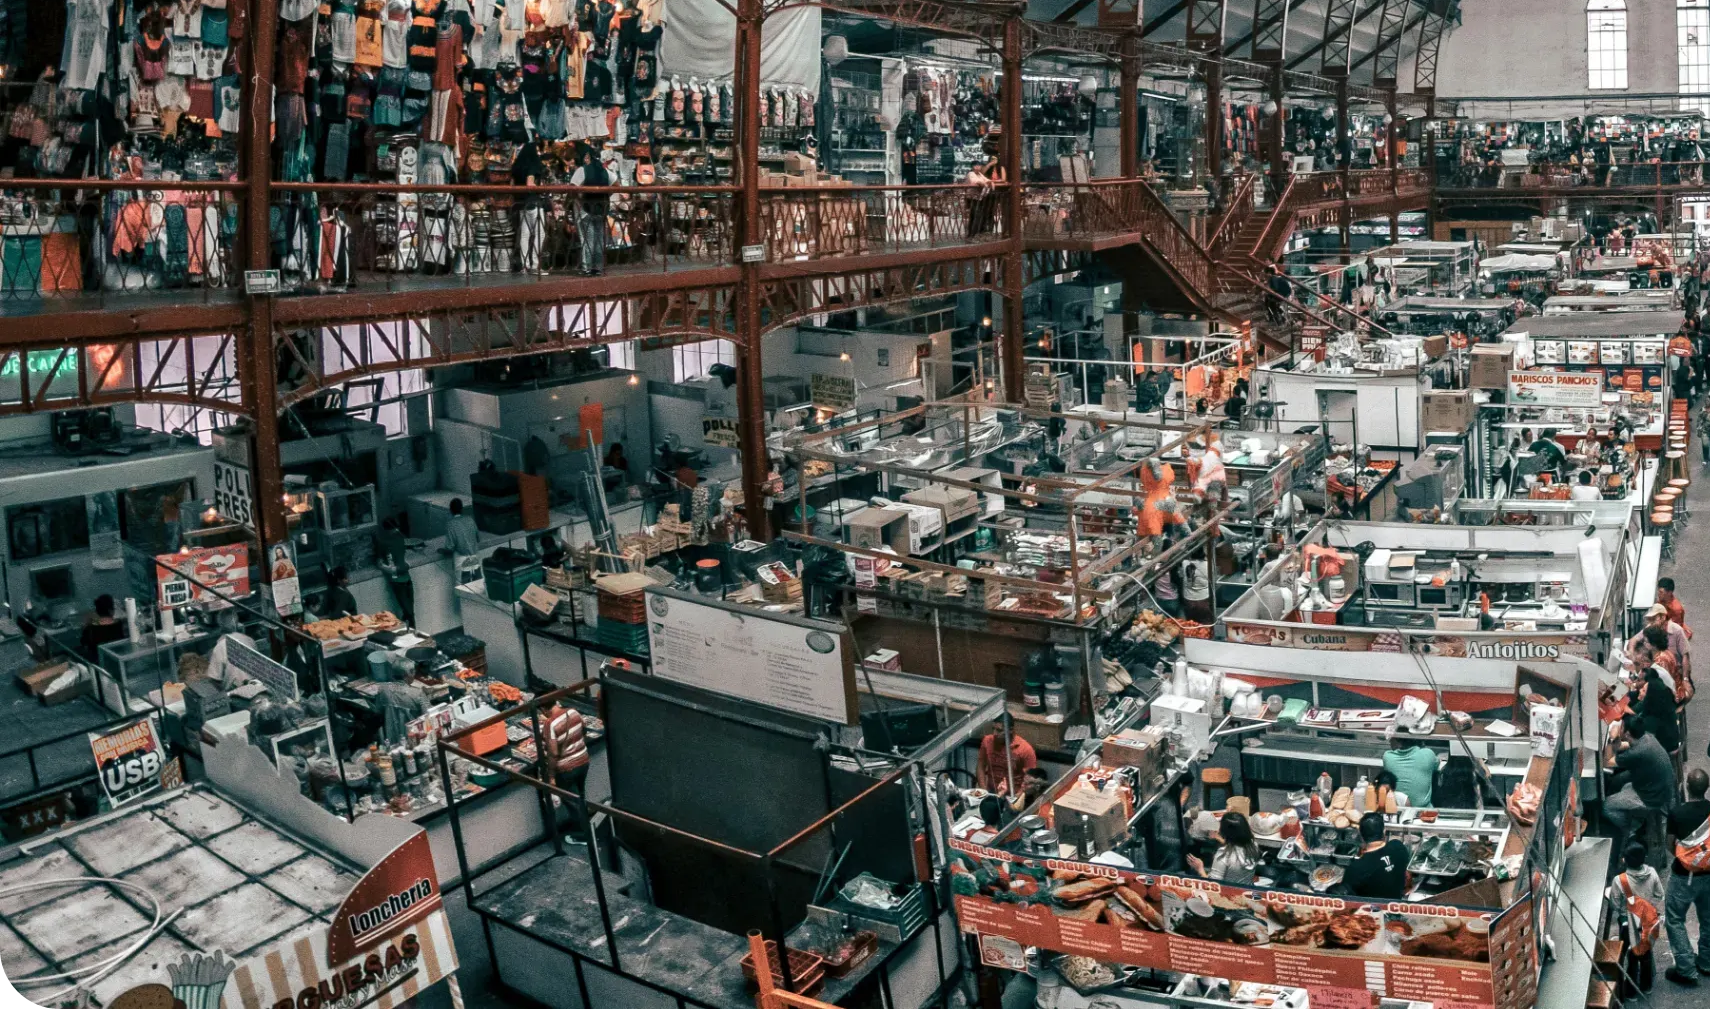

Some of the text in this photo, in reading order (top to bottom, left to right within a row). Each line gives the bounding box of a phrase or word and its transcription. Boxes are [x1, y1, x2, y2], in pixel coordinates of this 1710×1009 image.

[1511, 374, 1598, 385] MARISCOS PANCHO'S
[1303, 633, 1346, 644] Cubana
[1467, 641, 1559, 661] Antojitos
[107, 750, 161, 792] USB
[1046, 857, 1119, 879] BAGUETTE
[1160, 874, 1221, 893] FILETES
[1266, 891, 1346, 911] PECHUGAS
[1386, 901, 1460, 919] COMIDAS
